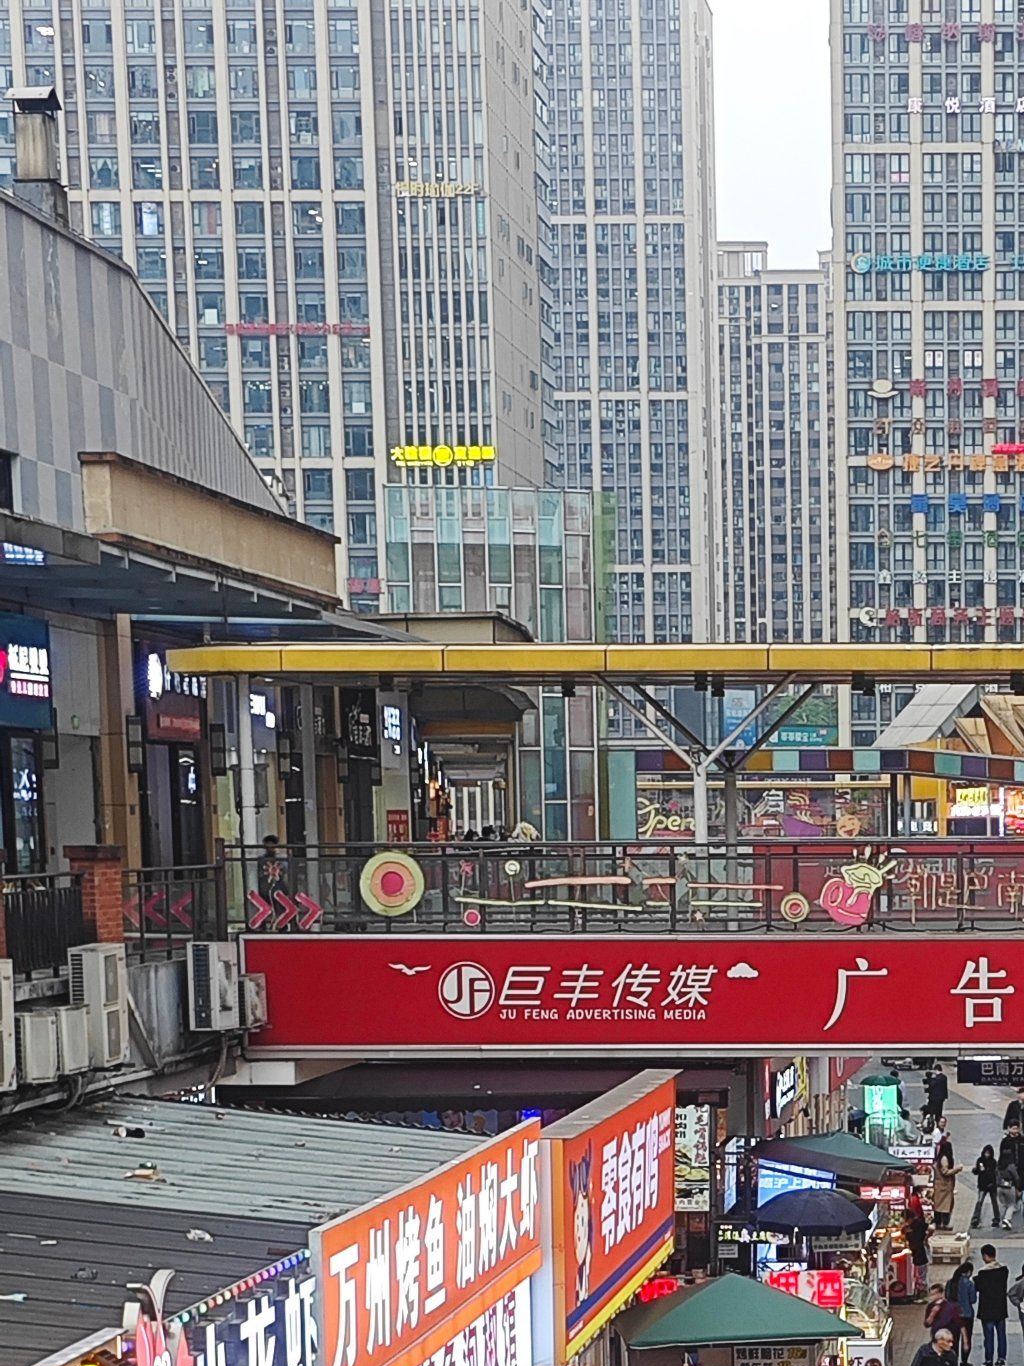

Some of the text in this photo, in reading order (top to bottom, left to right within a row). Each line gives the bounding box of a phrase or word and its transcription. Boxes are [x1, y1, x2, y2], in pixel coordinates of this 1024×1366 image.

[499, 963, 718, 1007] 巨丰传媒
[499, 1009, 706, 1021] JU FENG ADVERTISING MEDIA
[454, 1137, 540, 1289] 油焖大虾
[601, 1111, 659, 1255] 零食有鸣
